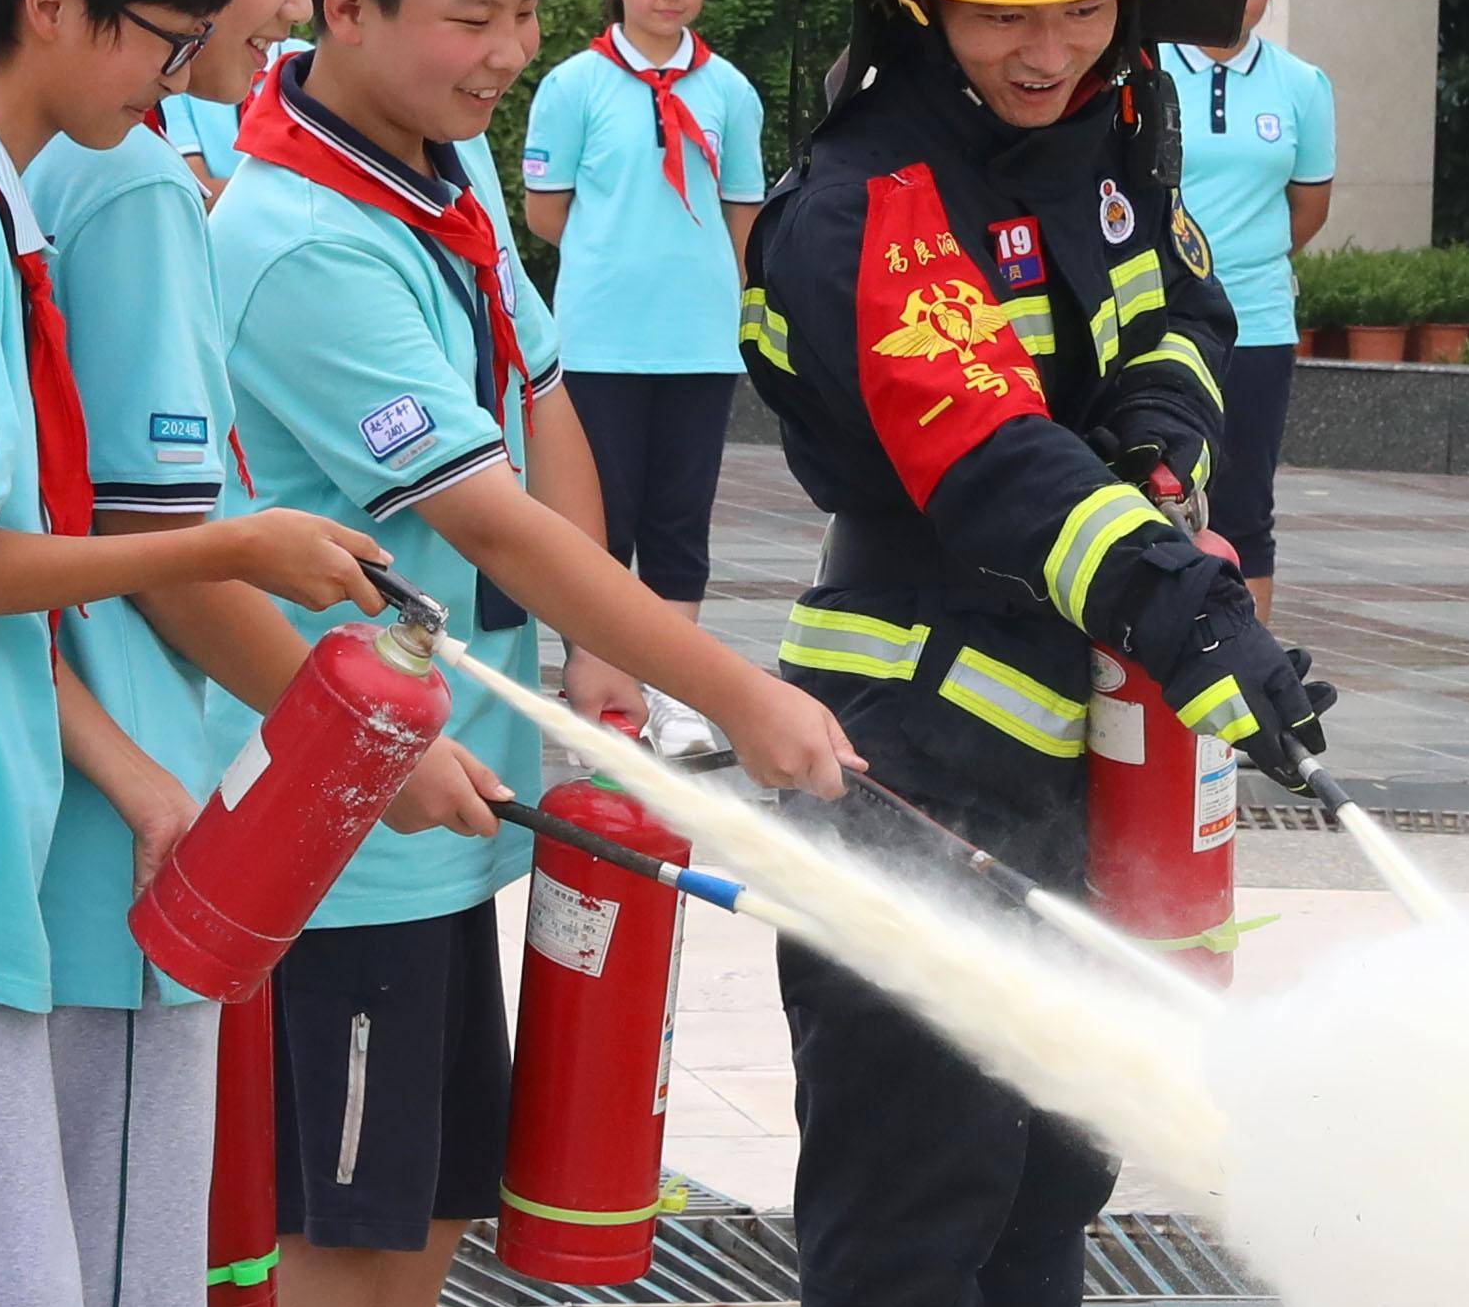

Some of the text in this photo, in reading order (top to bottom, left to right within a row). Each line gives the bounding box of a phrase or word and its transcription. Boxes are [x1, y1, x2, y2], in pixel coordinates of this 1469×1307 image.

[884, 231, 961, 273] 高良涧
[998, 224, 1032, 260] 19
